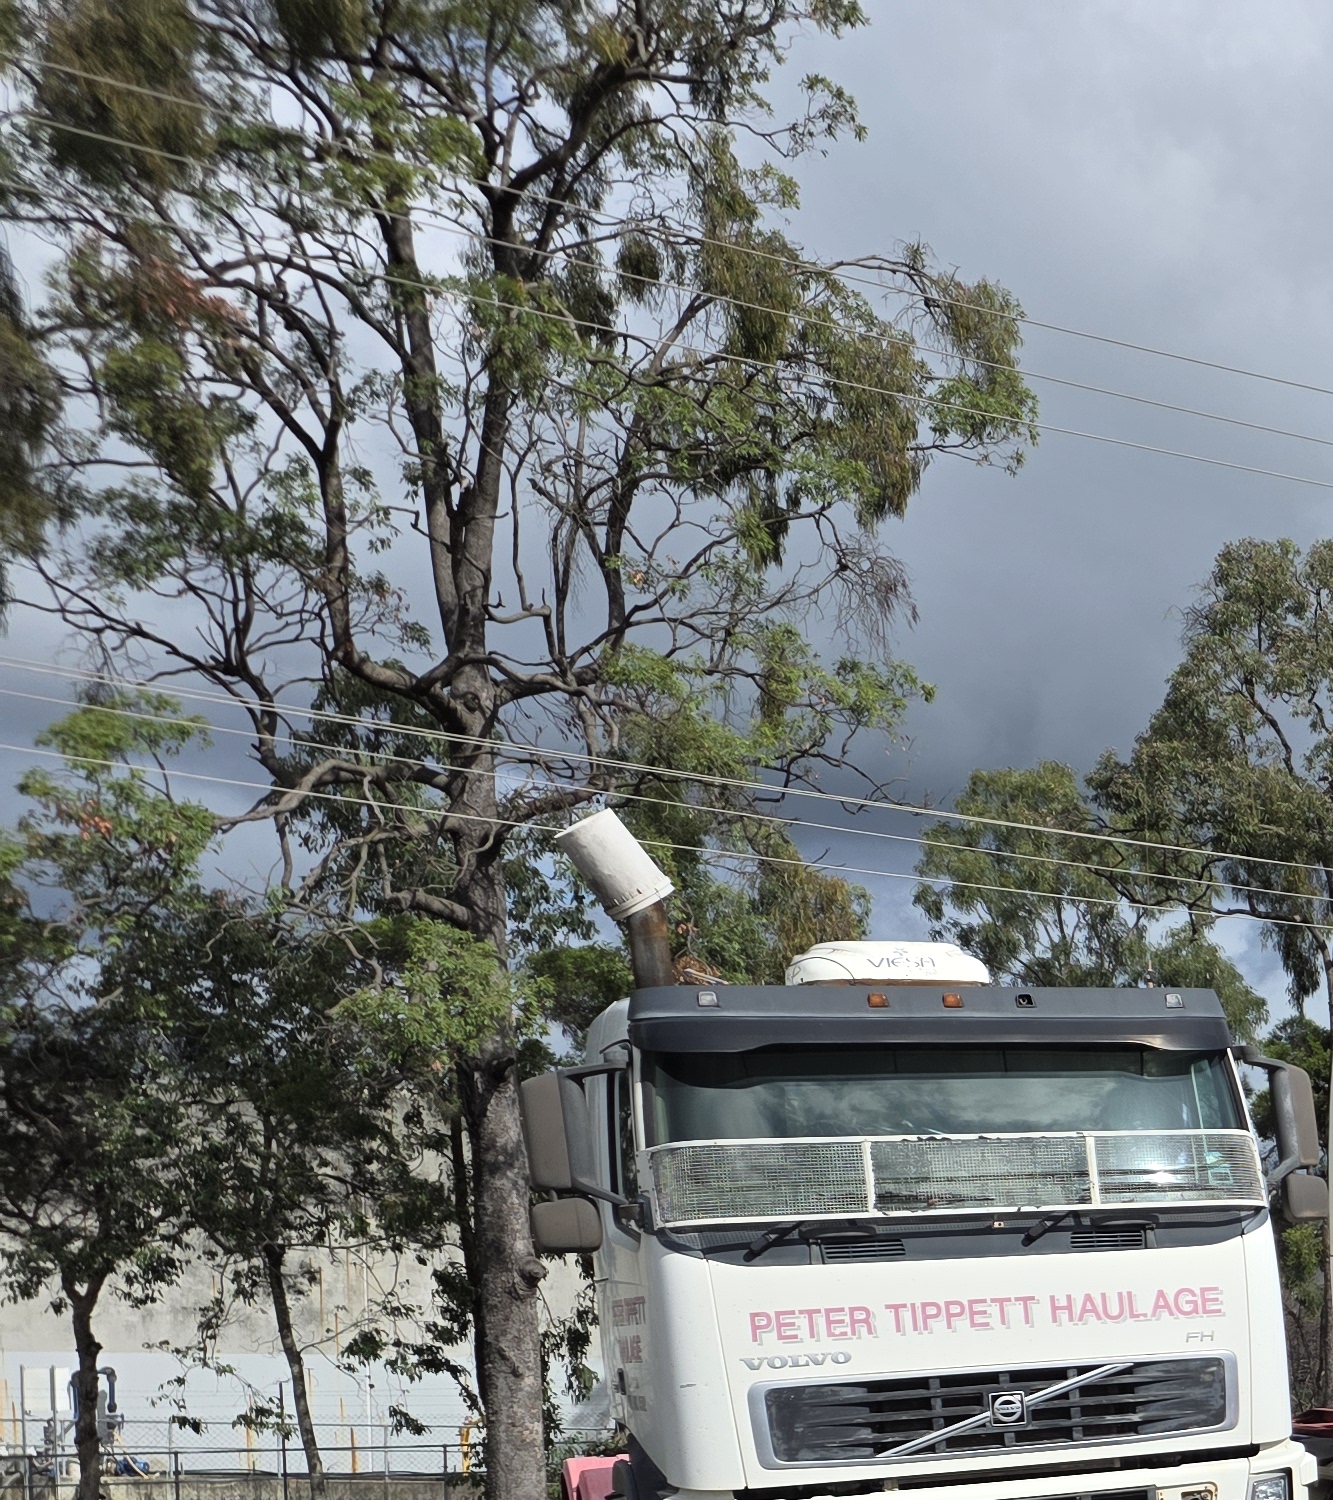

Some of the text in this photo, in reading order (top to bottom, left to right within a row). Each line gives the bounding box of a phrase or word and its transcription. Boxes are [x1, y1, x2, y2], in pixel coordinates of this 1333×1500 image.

[749, 1286, 1227, 1346] PETER TIPPETT HAULAGE
[1186, 1330, 1215, 1343] FH
[739, 1350, 852, 1371] VOLVO
